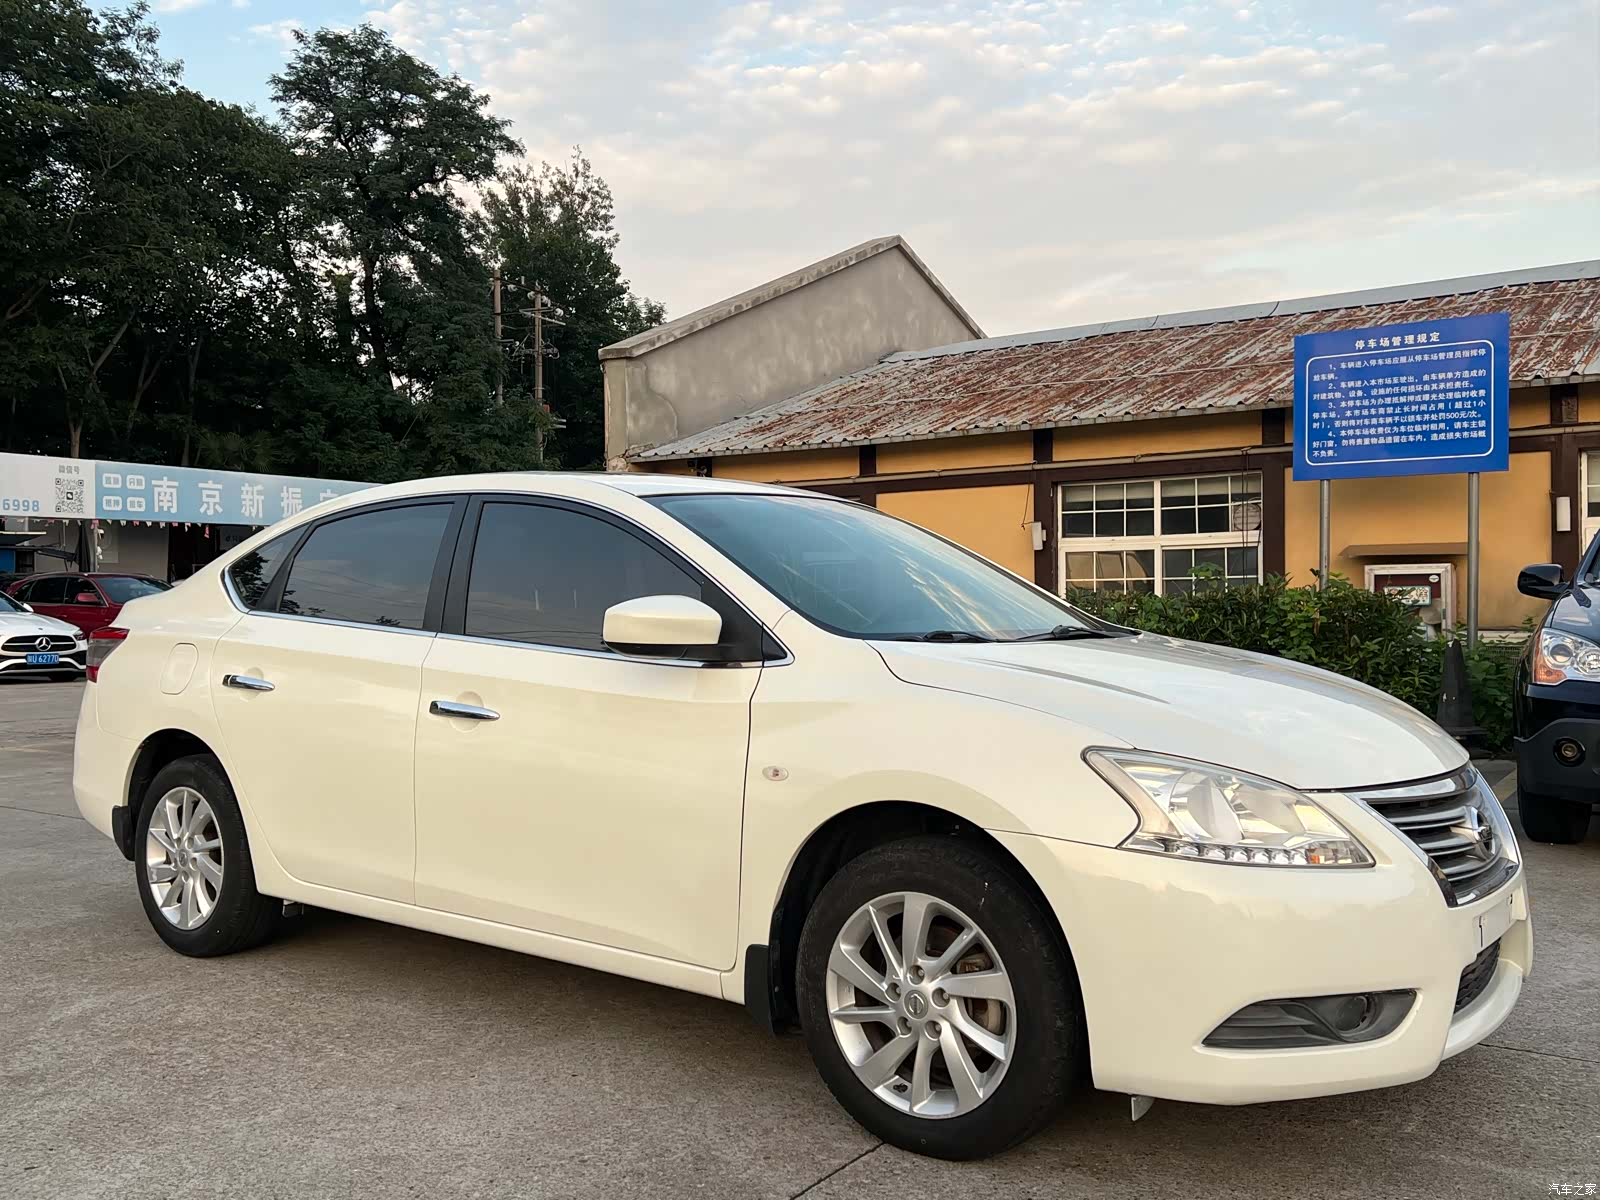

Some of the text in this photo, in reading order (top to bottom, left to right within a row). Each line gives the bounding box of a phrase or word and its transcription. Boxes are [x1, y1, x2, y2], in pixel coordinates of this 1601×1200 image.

[1354, 331, 1441, 350] 停车场管理规定
[2, 498, 40, 513] 6998
